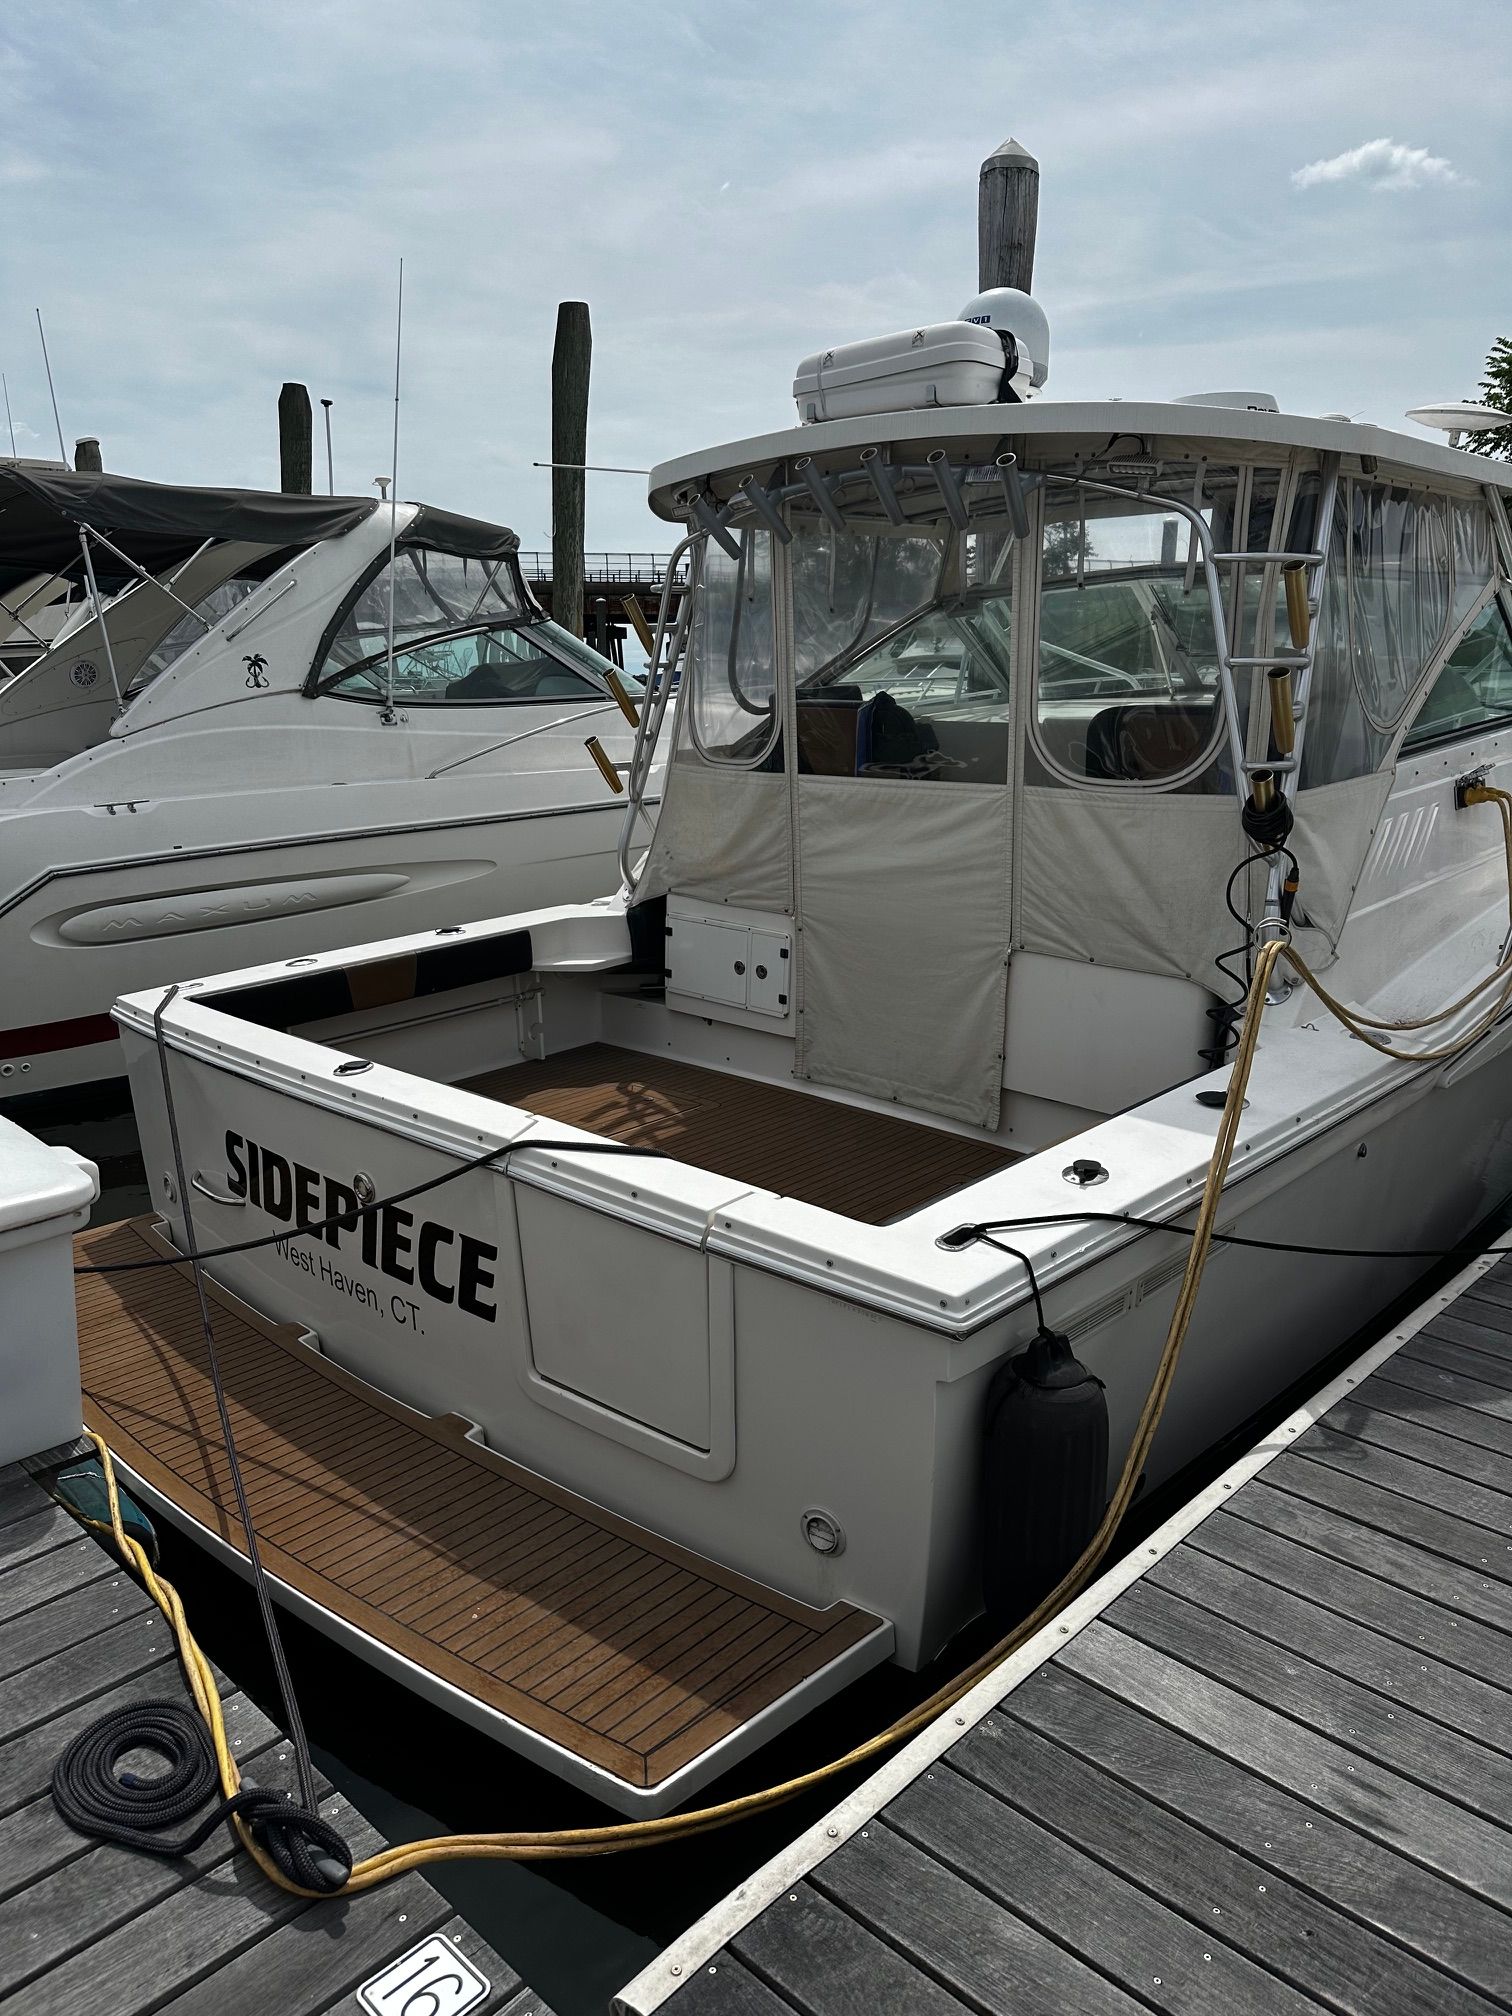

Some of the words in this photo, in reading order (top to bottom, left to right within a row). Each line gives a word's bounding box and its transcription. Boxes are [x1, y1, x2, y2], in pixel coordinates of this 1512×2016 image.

[102, 892, 319, 932] MAXUM
[225, 1129, 498, 1324] SIDEPIECE
[272, 1229, 316, 1276] West
[320, 1256, 385, 1319] Haven,
[390, 1295, 425, 1335] CT.
[382, 1955, 463, 2016] 16
